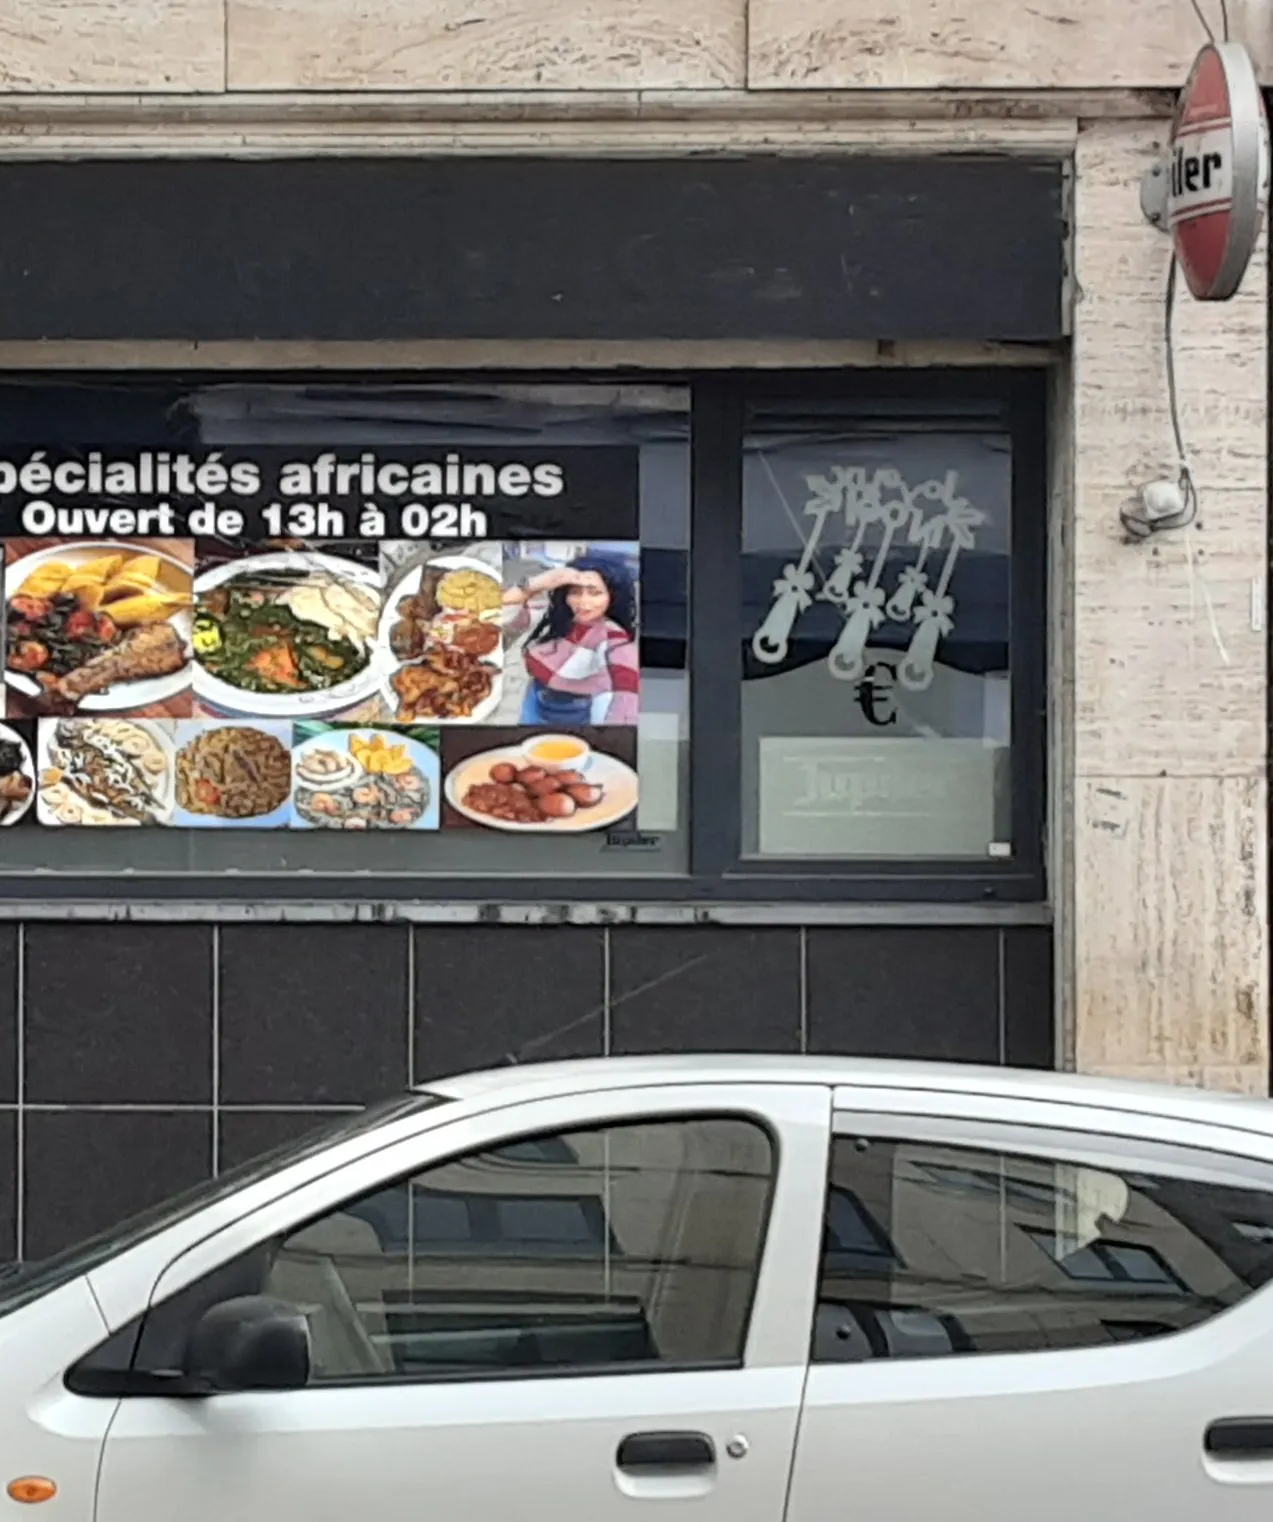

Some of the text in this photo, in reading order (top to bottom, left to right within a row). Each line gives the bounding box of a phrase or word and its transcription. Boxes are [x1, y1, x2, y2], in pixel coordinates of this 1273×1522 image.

[279, 453, 564, 496] africaines
[22, 501, 487, 536] Ouvert de 13h à 02h
